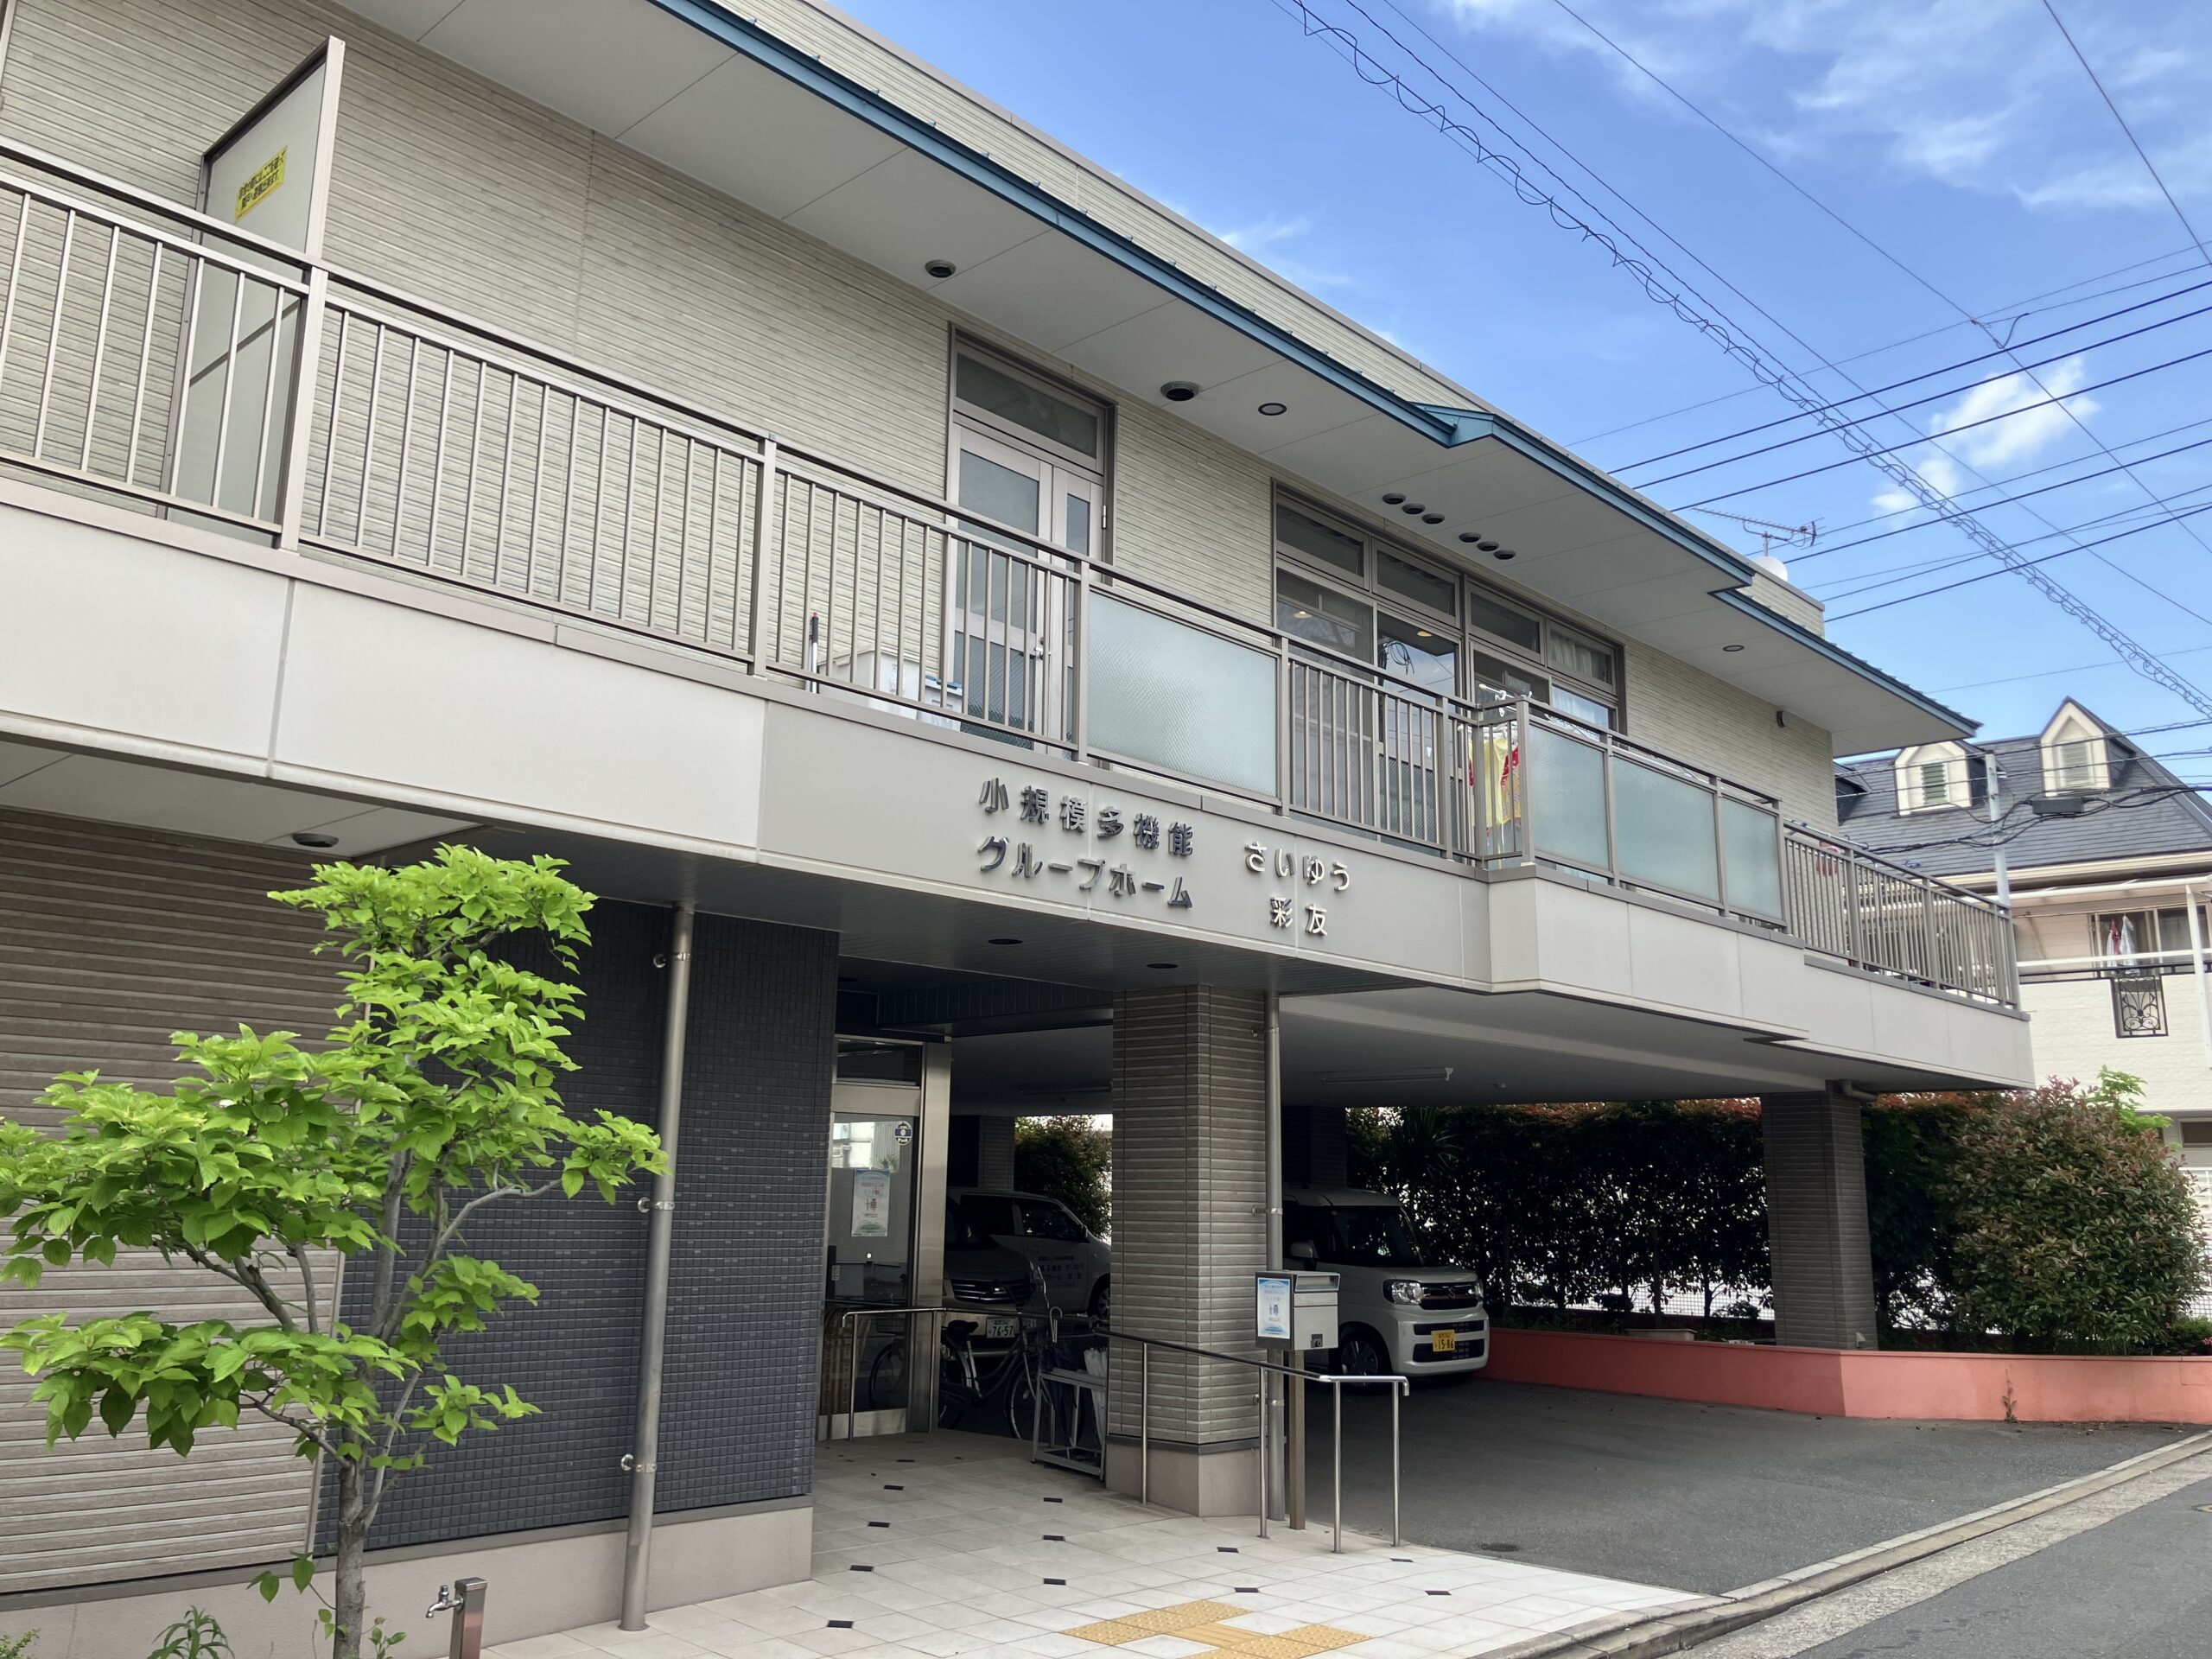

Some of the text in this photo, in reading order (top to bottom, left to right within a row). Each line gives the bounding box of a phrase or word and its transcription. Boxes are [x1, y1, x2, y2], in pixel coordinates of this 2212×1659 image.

[978, 778, 1350, 892] 小規模多機能 さいゆう
[977, 836, 1328, 937] グループホーム 彩友
[992, 1325, 1014, 1337] 76-57
[1438, 1338, 1454, 1350] 15-86
